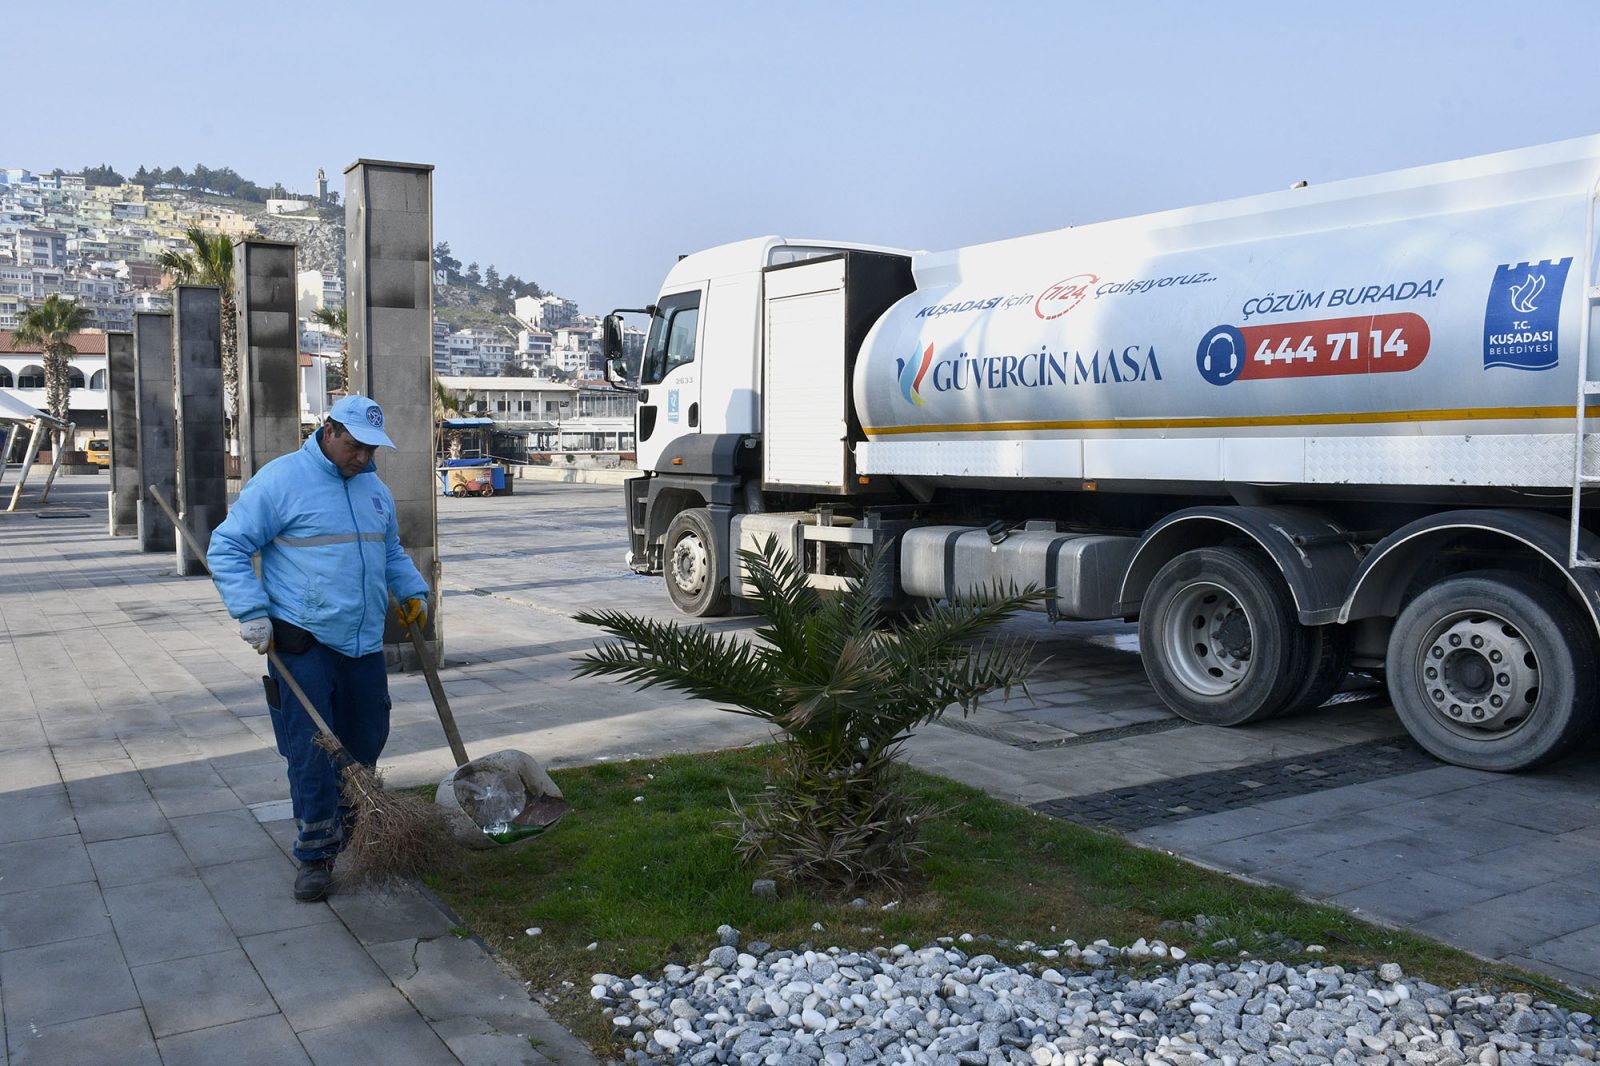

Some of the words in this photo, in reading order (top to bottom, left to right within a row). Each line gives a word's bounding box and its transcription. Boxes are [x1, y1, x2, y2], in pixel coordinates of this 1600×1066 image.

[915, 296, 1003, 319] KUŞADASI
[1001, 293, 1034, 310] için
[1045, 284, 1088, 301] 7/24
[1242, 289, 1325, 321] ÇÖZÜM
[1327, 278, 1444, 308] BURADA!
[1489, 330, 1553, 345] KUŞADASI
[1512, 320, 1531, 330] T.C.
[1254, 335, 1317, 365] 444
[1326, 332, 1359, 361] 71
[1370, 328, 1408, 358] 14
[1489, 342, 1553, 355] BELEDİYESİ
[932, 345, 1069, 392] GÜVERCİN
[1073, 345, 1163, 385] MASA
